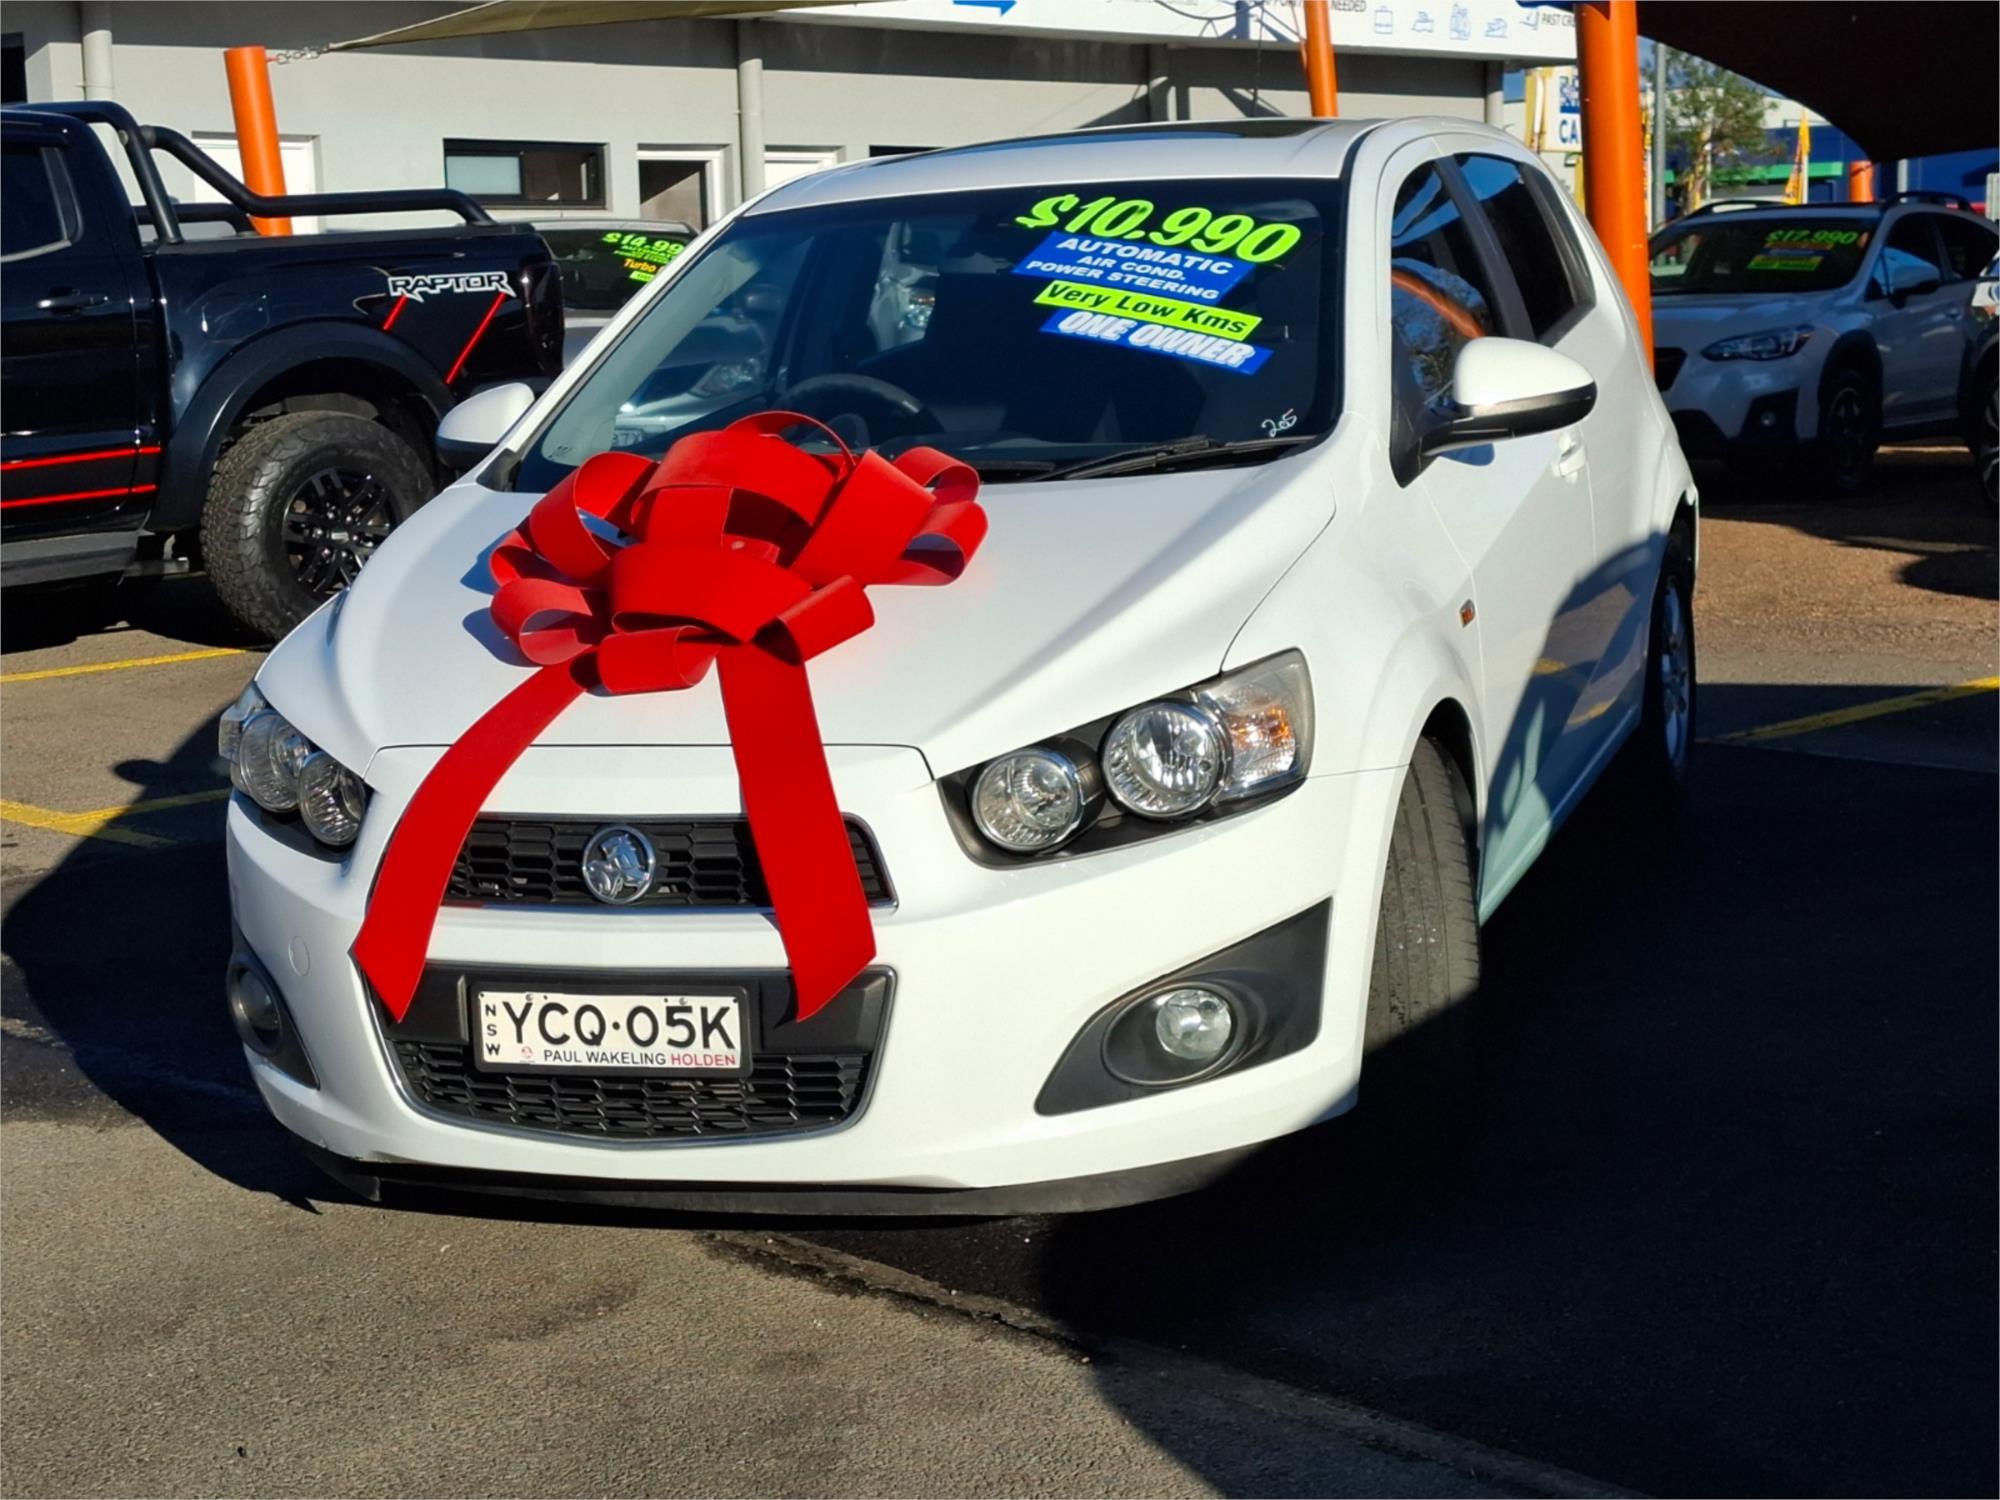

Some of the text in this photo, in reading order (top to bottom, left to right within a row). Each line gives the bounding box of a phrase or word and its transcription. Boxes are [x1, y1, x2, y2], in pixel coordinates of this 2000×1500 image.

[1015, 193, 1301, 263] $10.990
[1056, 237, 1234, 276] AUTOMATIC
[1077, 255, 1187, 281] AIR COND.
[387, 271, 517, 303] RAPTOR
[1026, 259, 1220, 300] POWER STEERING
[1046, 283, 1248, 334] Very Low Kms
[1057, 310, 1257, 369] ONE OWNER
[544, 1049, 736, 1066] PAUL WAKELING HOLDEN
